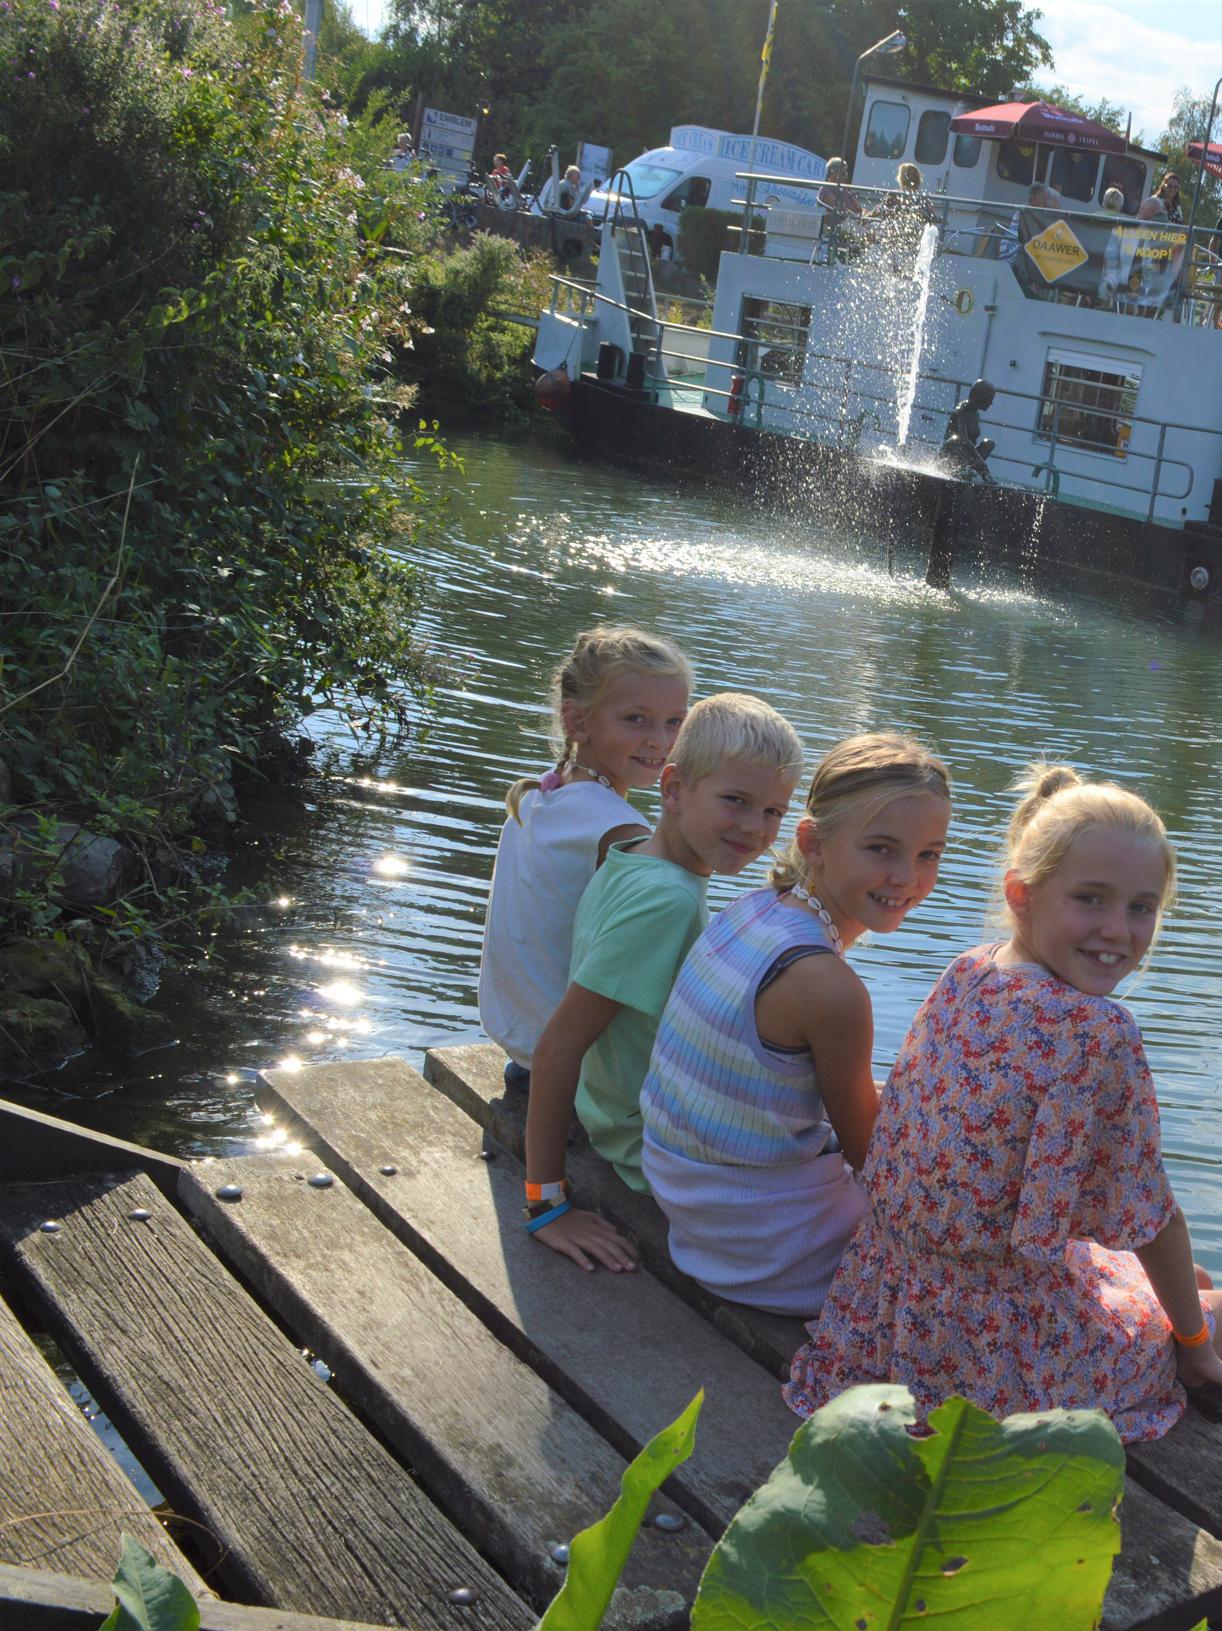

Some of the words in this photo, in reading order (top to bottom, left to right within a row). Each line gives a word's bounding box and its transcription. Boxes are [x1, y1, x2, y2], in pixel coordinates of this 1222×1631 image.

[439, 112, 473, 127] EMBLEM
[725, 139, 749, 158] ICE
[1159, 231, 1187, 244] HIER
[1033, 239, 1081, 258] DAAWER
[1136, 247, 1172, 260] KOOP!
